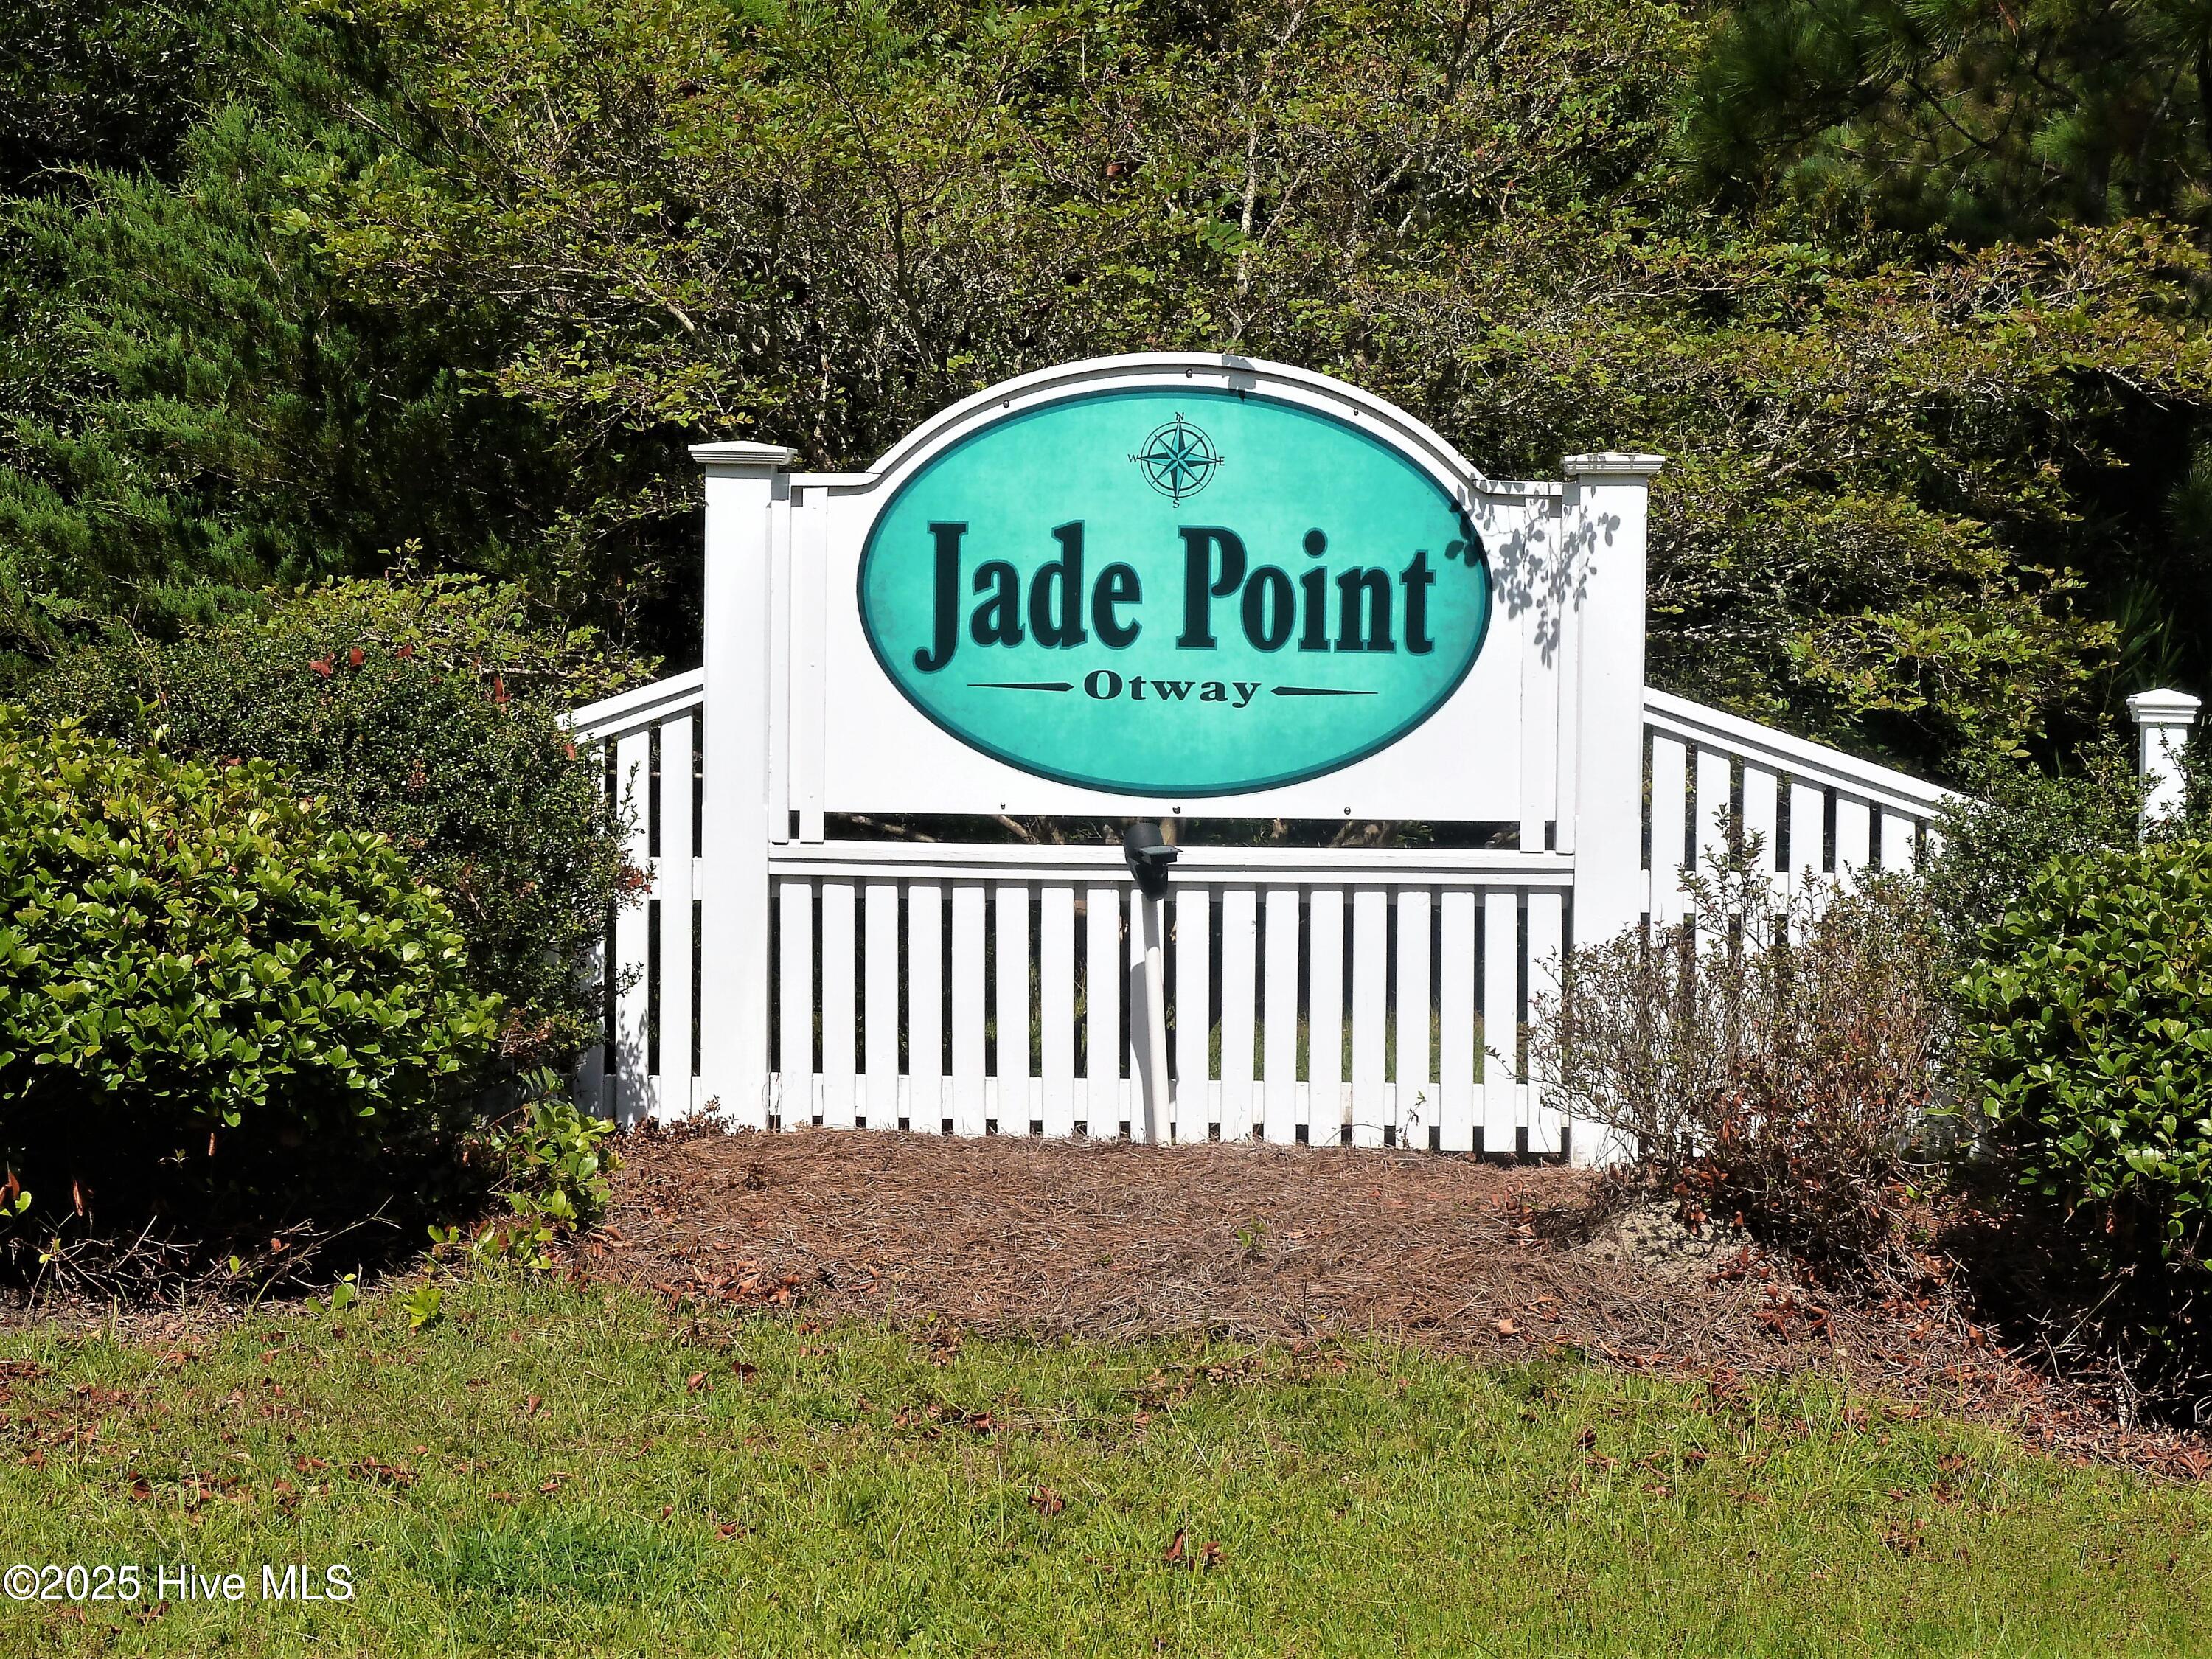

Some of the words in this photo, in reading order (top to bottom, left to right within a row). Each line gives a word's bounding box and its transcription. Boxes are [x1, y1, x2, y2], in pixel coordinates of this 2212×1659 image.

[1175, 412, 1184, 420] N
[1127, 454, 1139, 462] W
[1219, 456, 1225, 465] E
[1172, 498, 1180, 508] S
[914, 519, 1143, 673] Jade
[1176, 524, 1436, 655] Point
[1084, 669, 1262, 709] Otway
